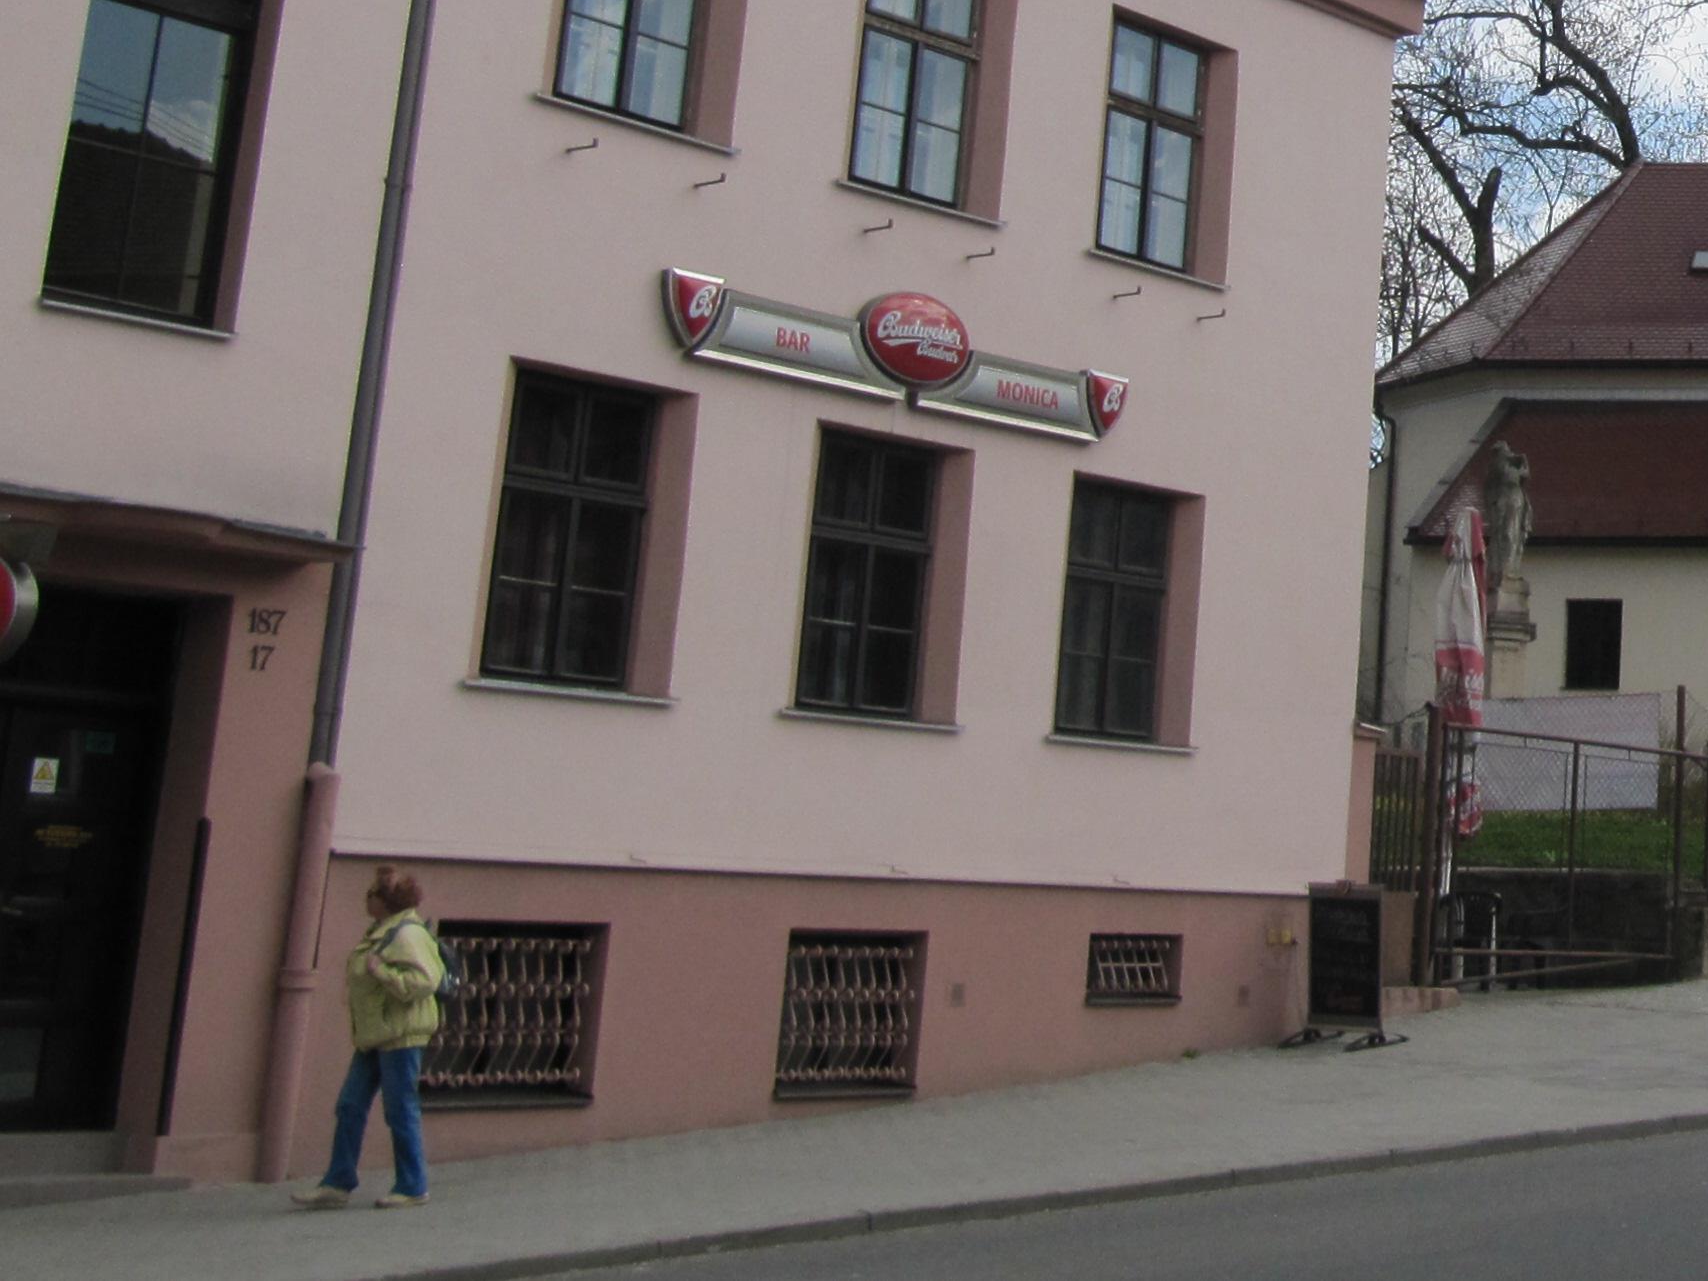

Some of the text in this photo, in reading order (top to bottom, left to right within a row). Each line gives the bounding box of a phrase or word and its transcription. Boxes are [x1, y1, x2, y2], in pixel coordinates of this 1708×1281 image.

[776, 327, 811, 353] BAR
[877, 310, 962, 346] Budweiser
[996, 379, 1059, 409] MONICA
[248, 607, 287, 635] 187
[250, 645, 276, 672] 17
